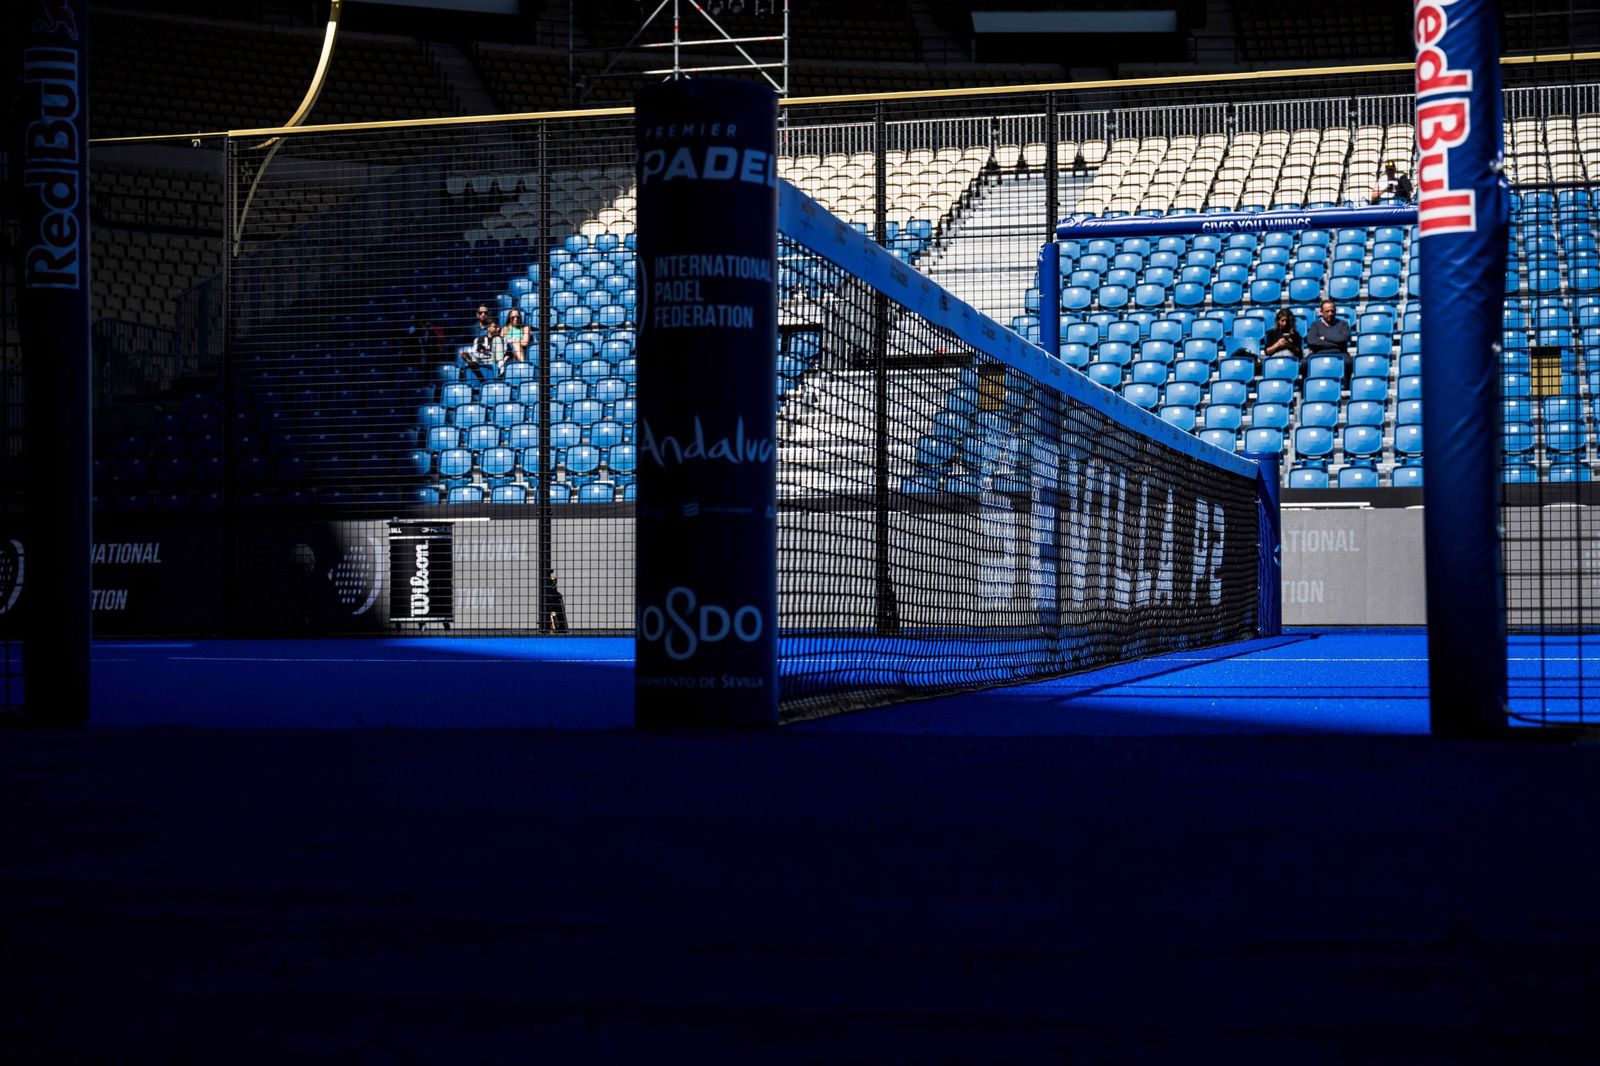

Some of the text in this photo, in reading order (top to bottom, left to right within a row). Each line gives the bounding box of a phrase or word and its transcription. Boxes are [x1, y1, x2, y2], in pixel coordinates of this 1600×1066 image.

[643, 120, 738, 142] PREMIER
[653, 279, 704, 302] PADEL
[653, 304, 755, 329] FEDERATION
[1190, 498, 1227, 606] P2
[410, 540, 430, 617] Wilson
